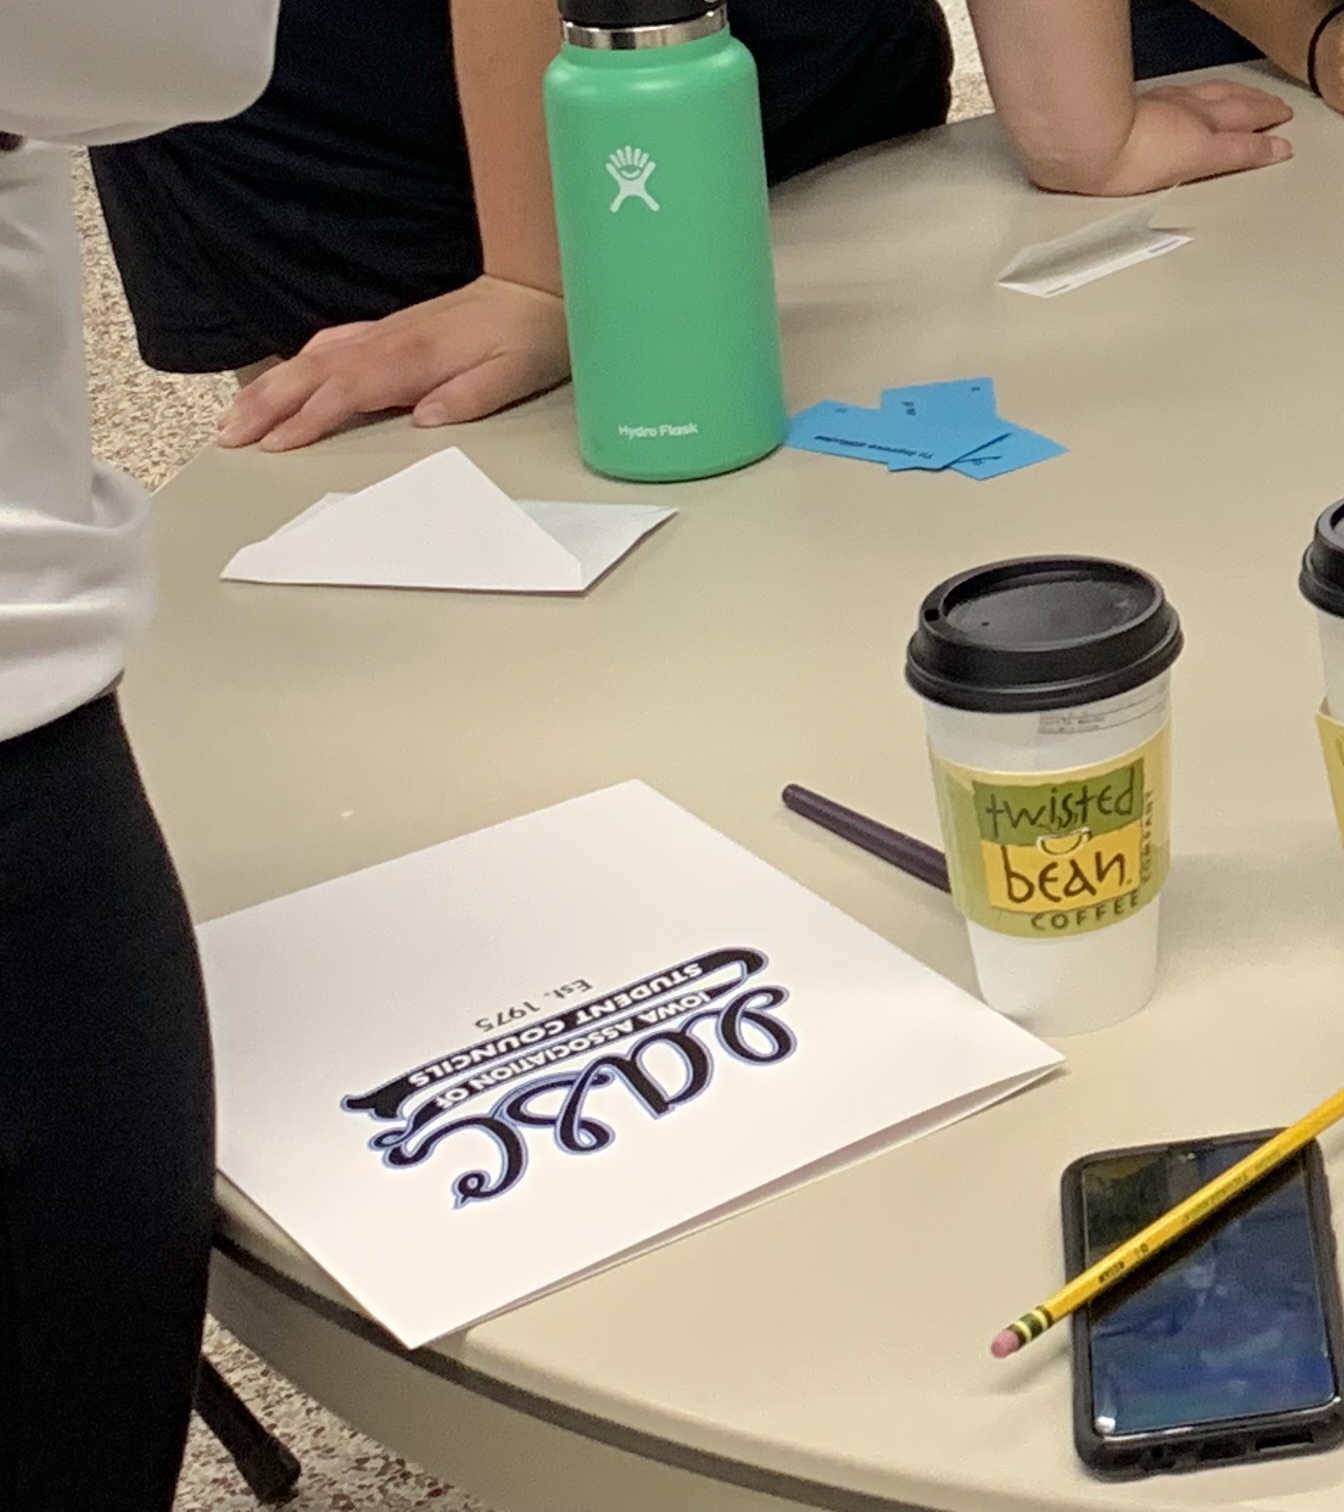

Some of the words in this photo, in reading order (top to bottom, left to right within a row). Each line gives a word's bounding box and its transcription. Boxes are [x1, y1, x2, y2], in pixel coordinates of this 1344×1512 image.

[617, 424, 658, 440] Hydro
[659, 423, 699, 437] Flask
[986, 766, 1135, 838] twisted
[1031, 889, 1139, 931] COFFEE
[543, 977, 593, 1004] Est.
[575, 961, 703, 1024] STUDENT
[636, 989, 711, 1025] IOWA
[473, 1000, 537, 1032] 1975
[407, 1020, 564, 1089] COUNCILS
[472, 1016, 633, 1092] ASSOCIATION
[433, 1082, 472, 1111] OF
